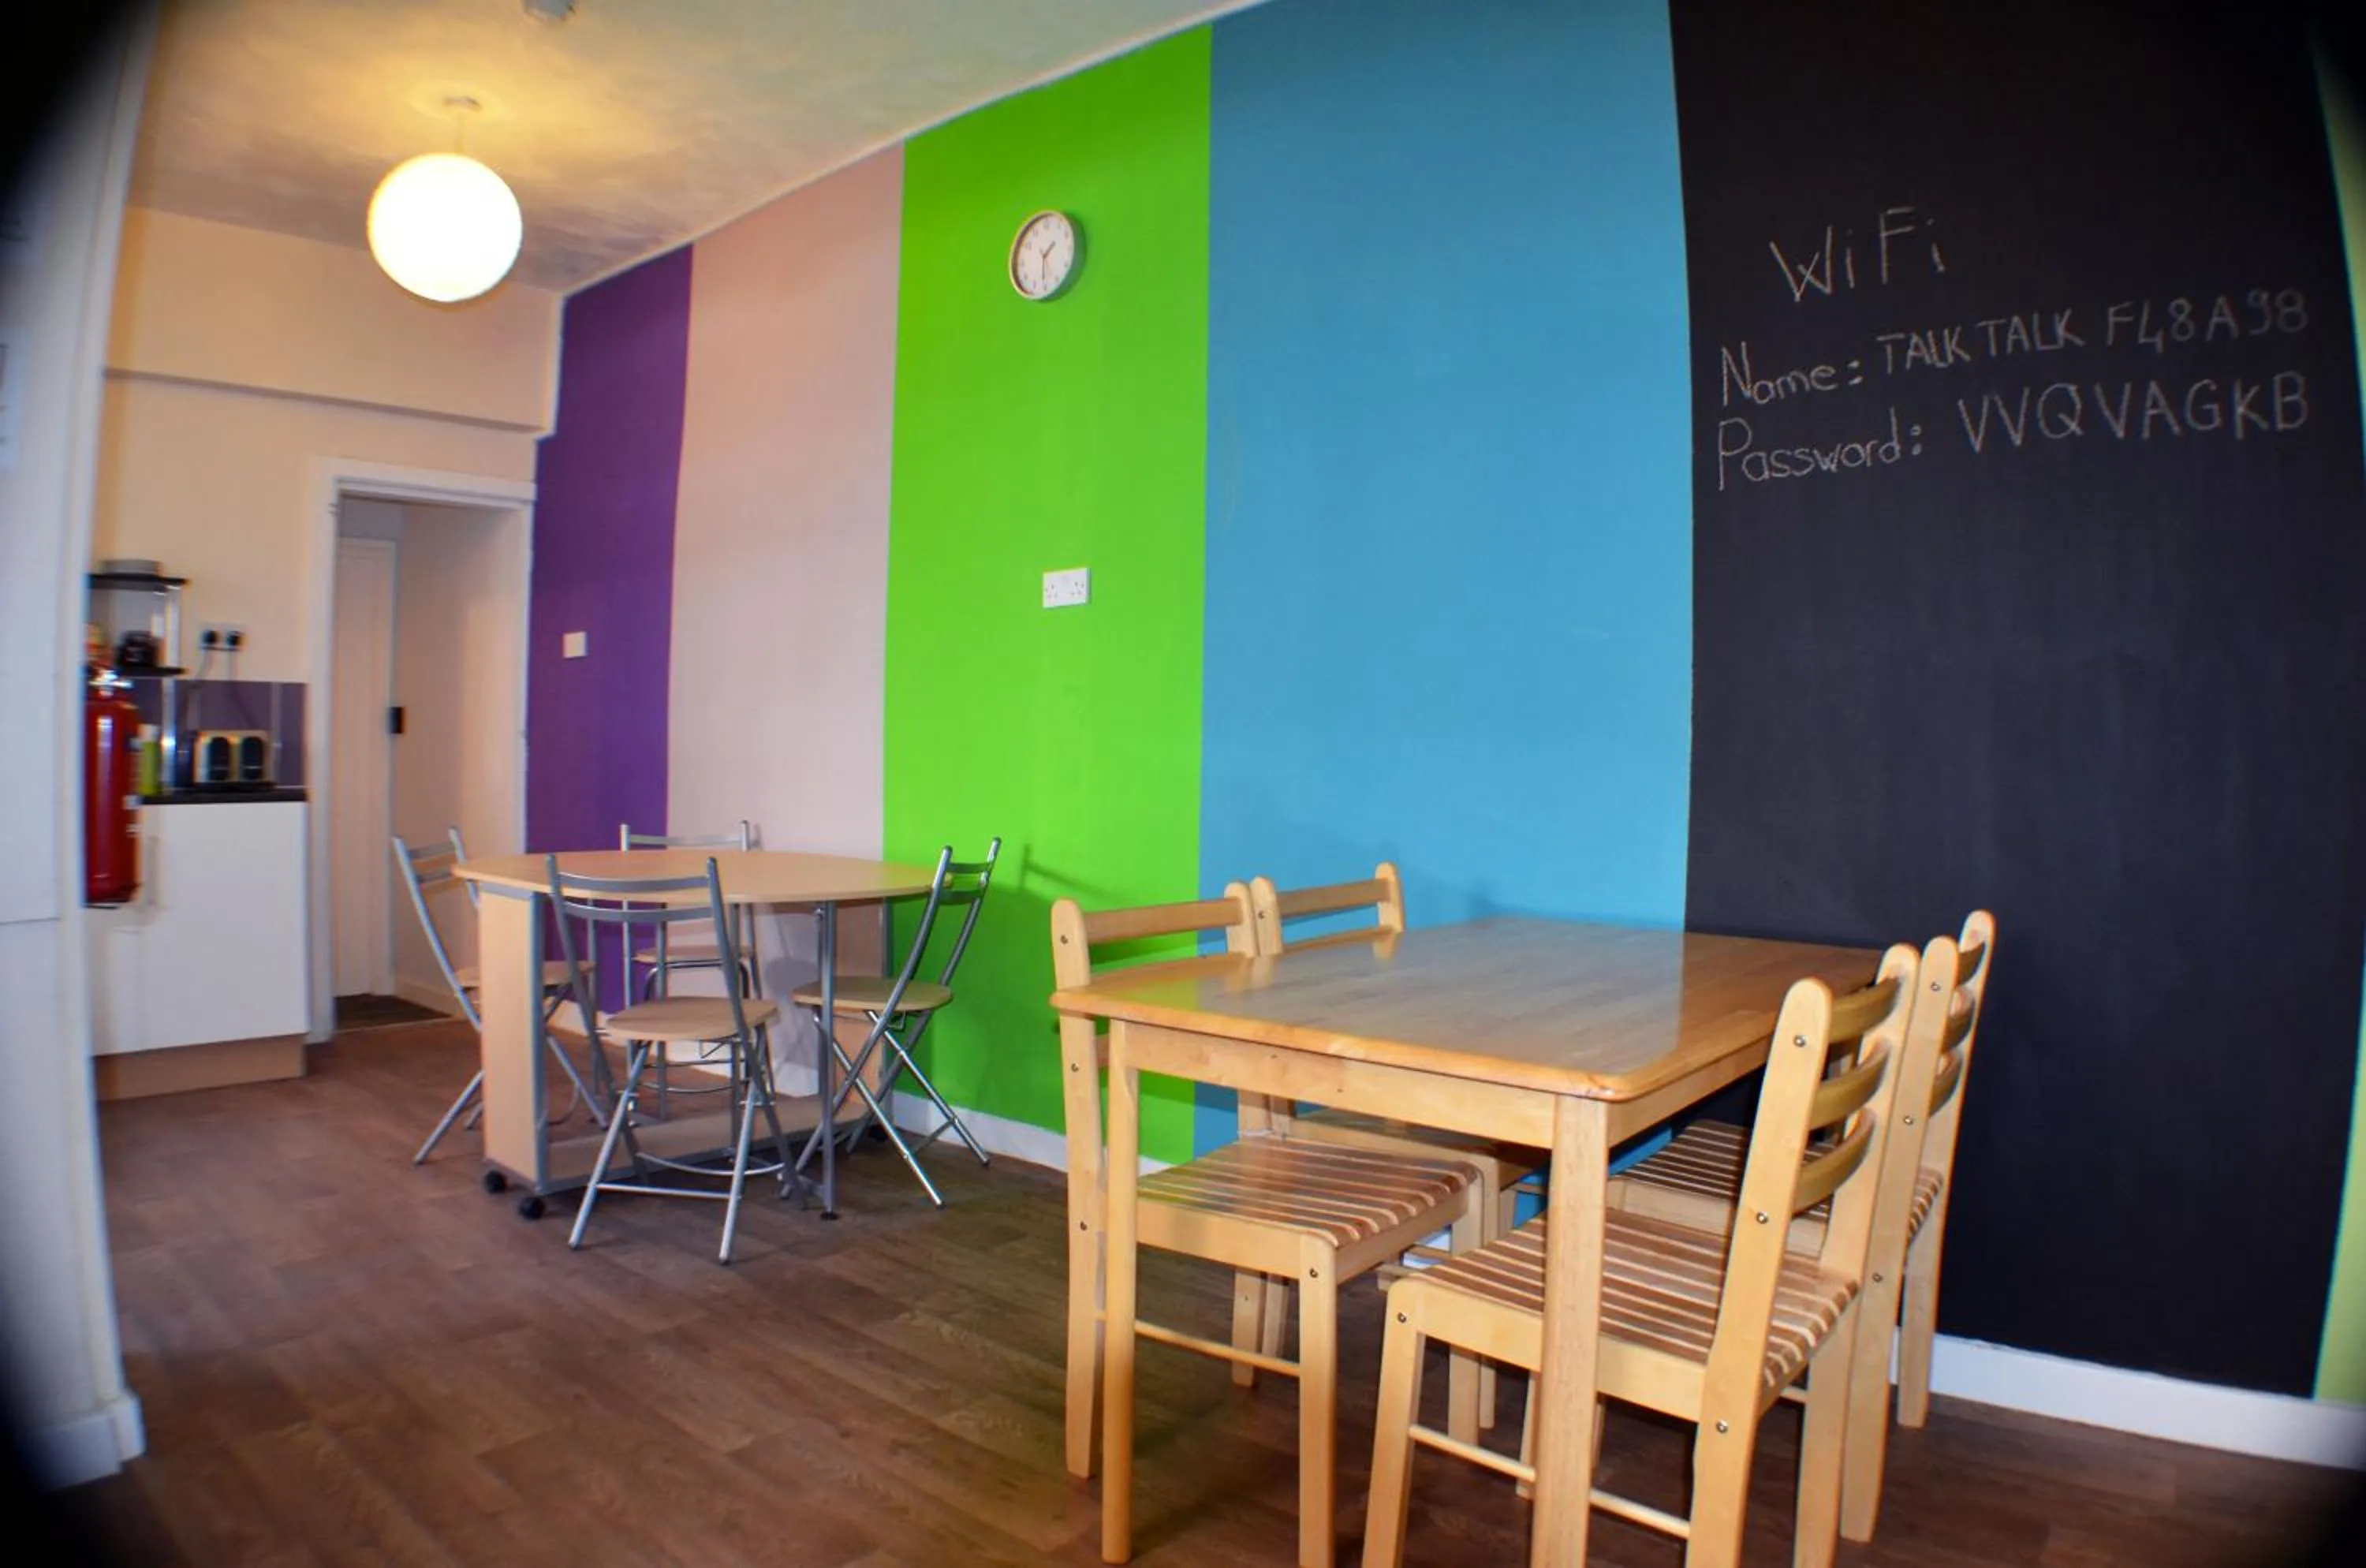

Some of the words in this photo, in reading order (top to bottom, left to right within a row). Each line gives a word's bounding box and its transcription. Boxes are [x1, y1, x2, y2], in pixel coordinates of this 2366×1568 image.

[1768, 205, 1947, 303] WiFi
[1721, 340, 1864, 406] Name:
[1717, 406, 1923, 492] Password:
